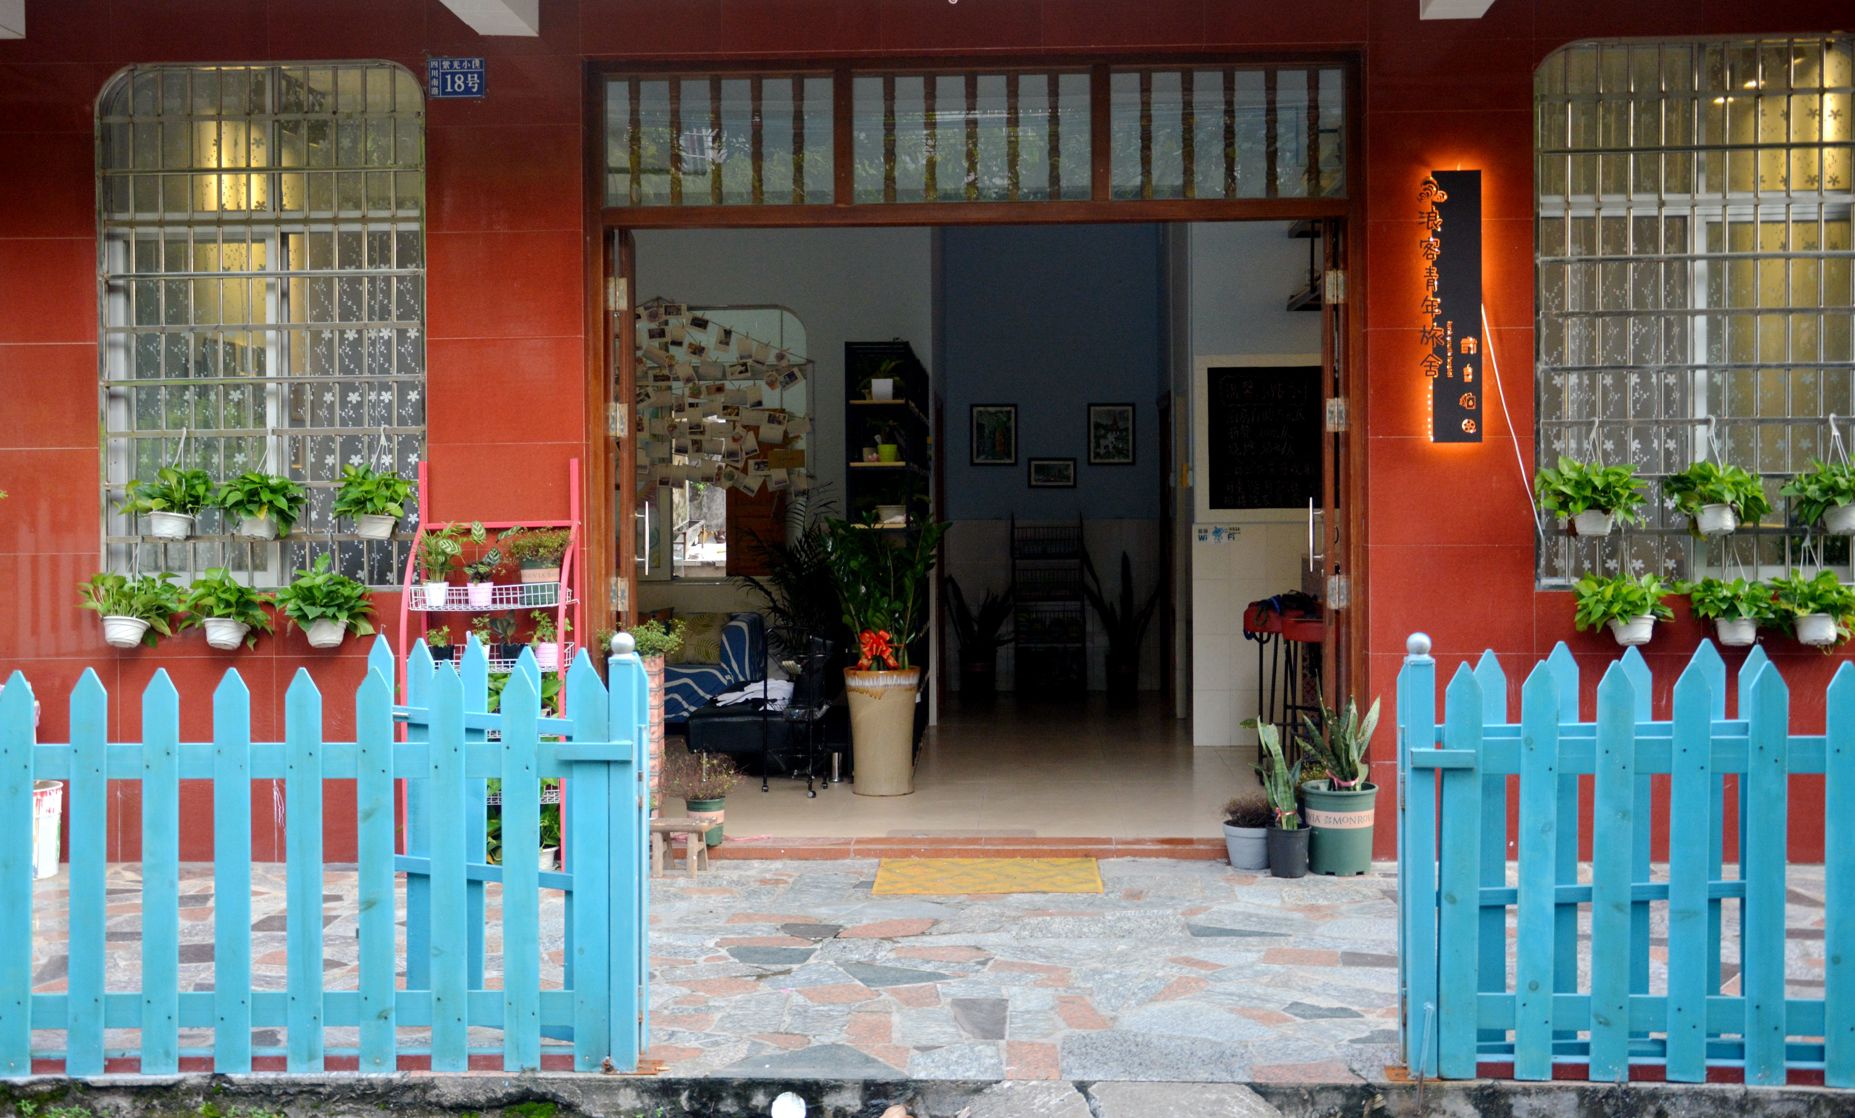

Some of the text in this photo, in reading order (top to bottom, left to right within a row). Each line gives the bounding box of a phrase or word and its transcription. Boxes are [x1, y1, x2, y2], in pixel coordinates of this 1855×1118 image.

[444, 73, 480, 92] 18号
[1418, 206, 1445, 378] 浪客青年旅舍
